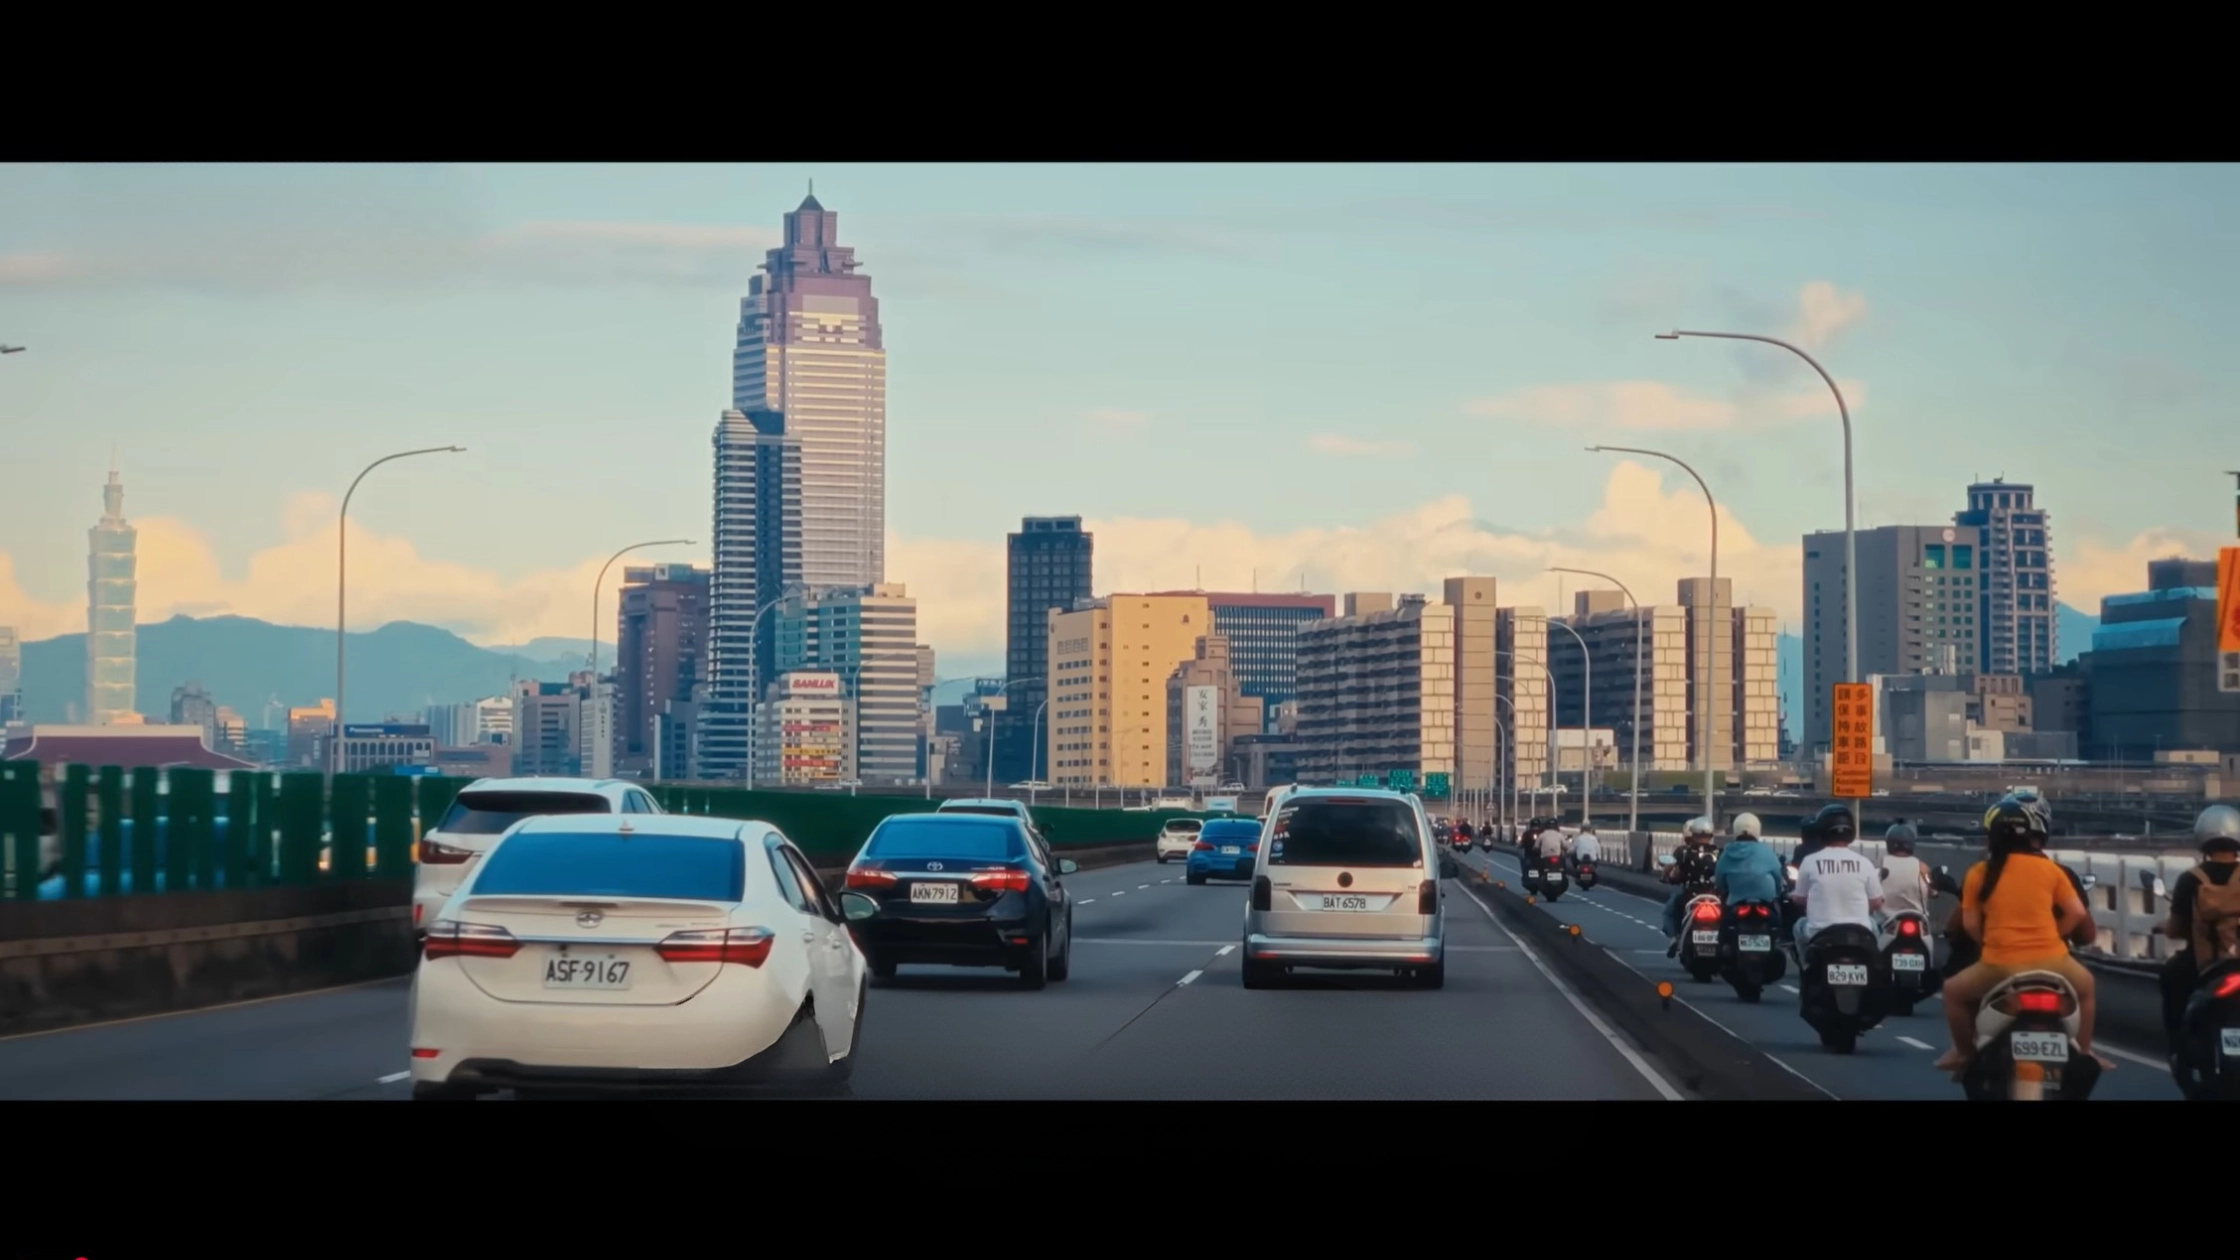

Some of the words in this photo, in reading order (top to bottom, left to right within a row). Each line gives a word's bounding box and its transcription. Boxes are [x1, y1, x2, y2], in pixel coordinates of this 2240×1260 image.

[792, 679, 835, 689] SANLUX
[1854, 687, 1868, 765] 多事故路段
[546, 959, 630, 983] ASF-9167
